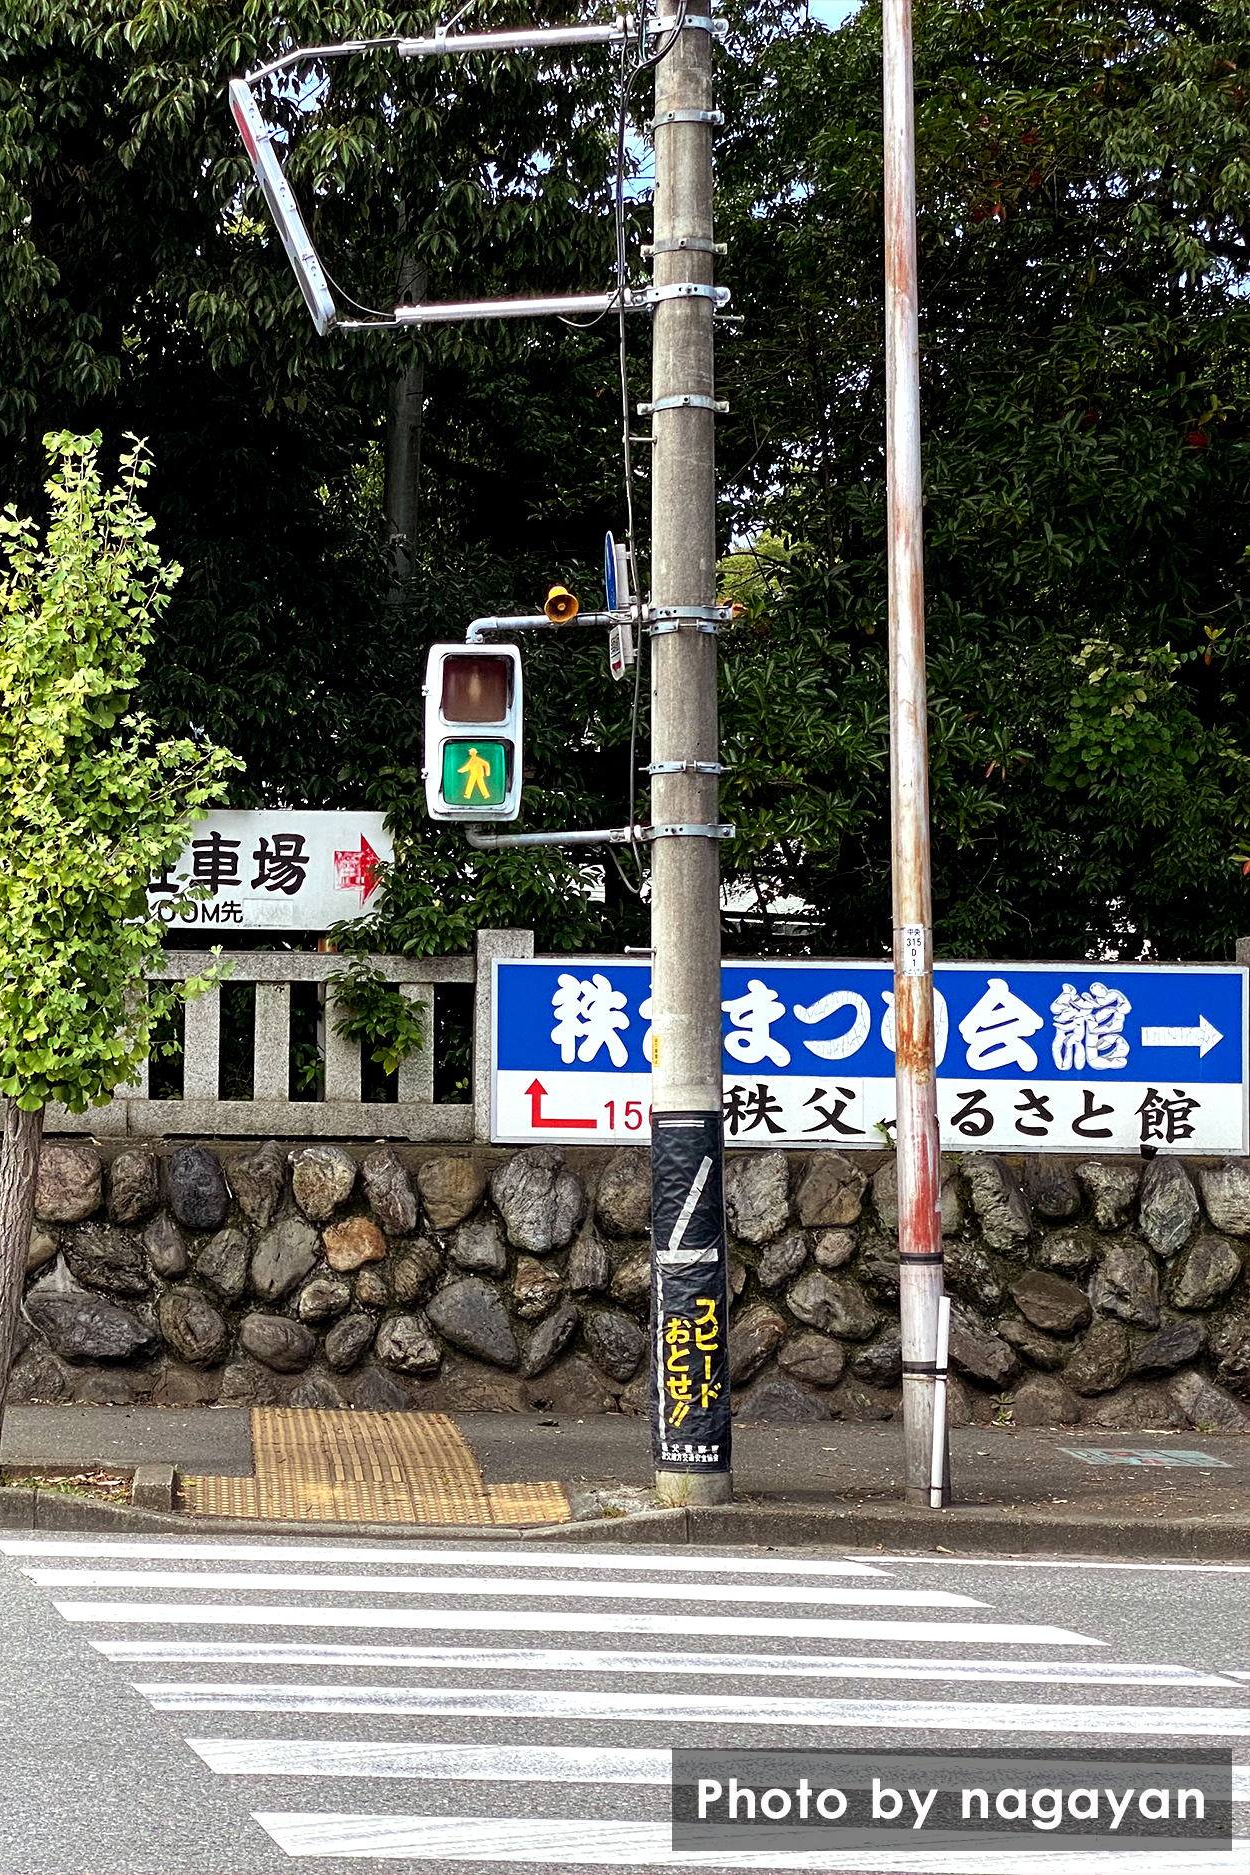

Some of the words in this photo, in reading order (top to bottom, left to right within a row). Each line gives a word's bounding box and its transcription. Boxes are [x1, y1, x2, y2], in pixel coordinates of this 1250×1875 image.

[906, 937, 922, 947] 315
[911, 948, 917, 957] D
[912, 958, 916, 967] 1
[604, 1100, 654, 1131] 15
[722, 1083, 1202, 1144] 秩父るさと館
[694, 1298, 721, 1408] スピード
